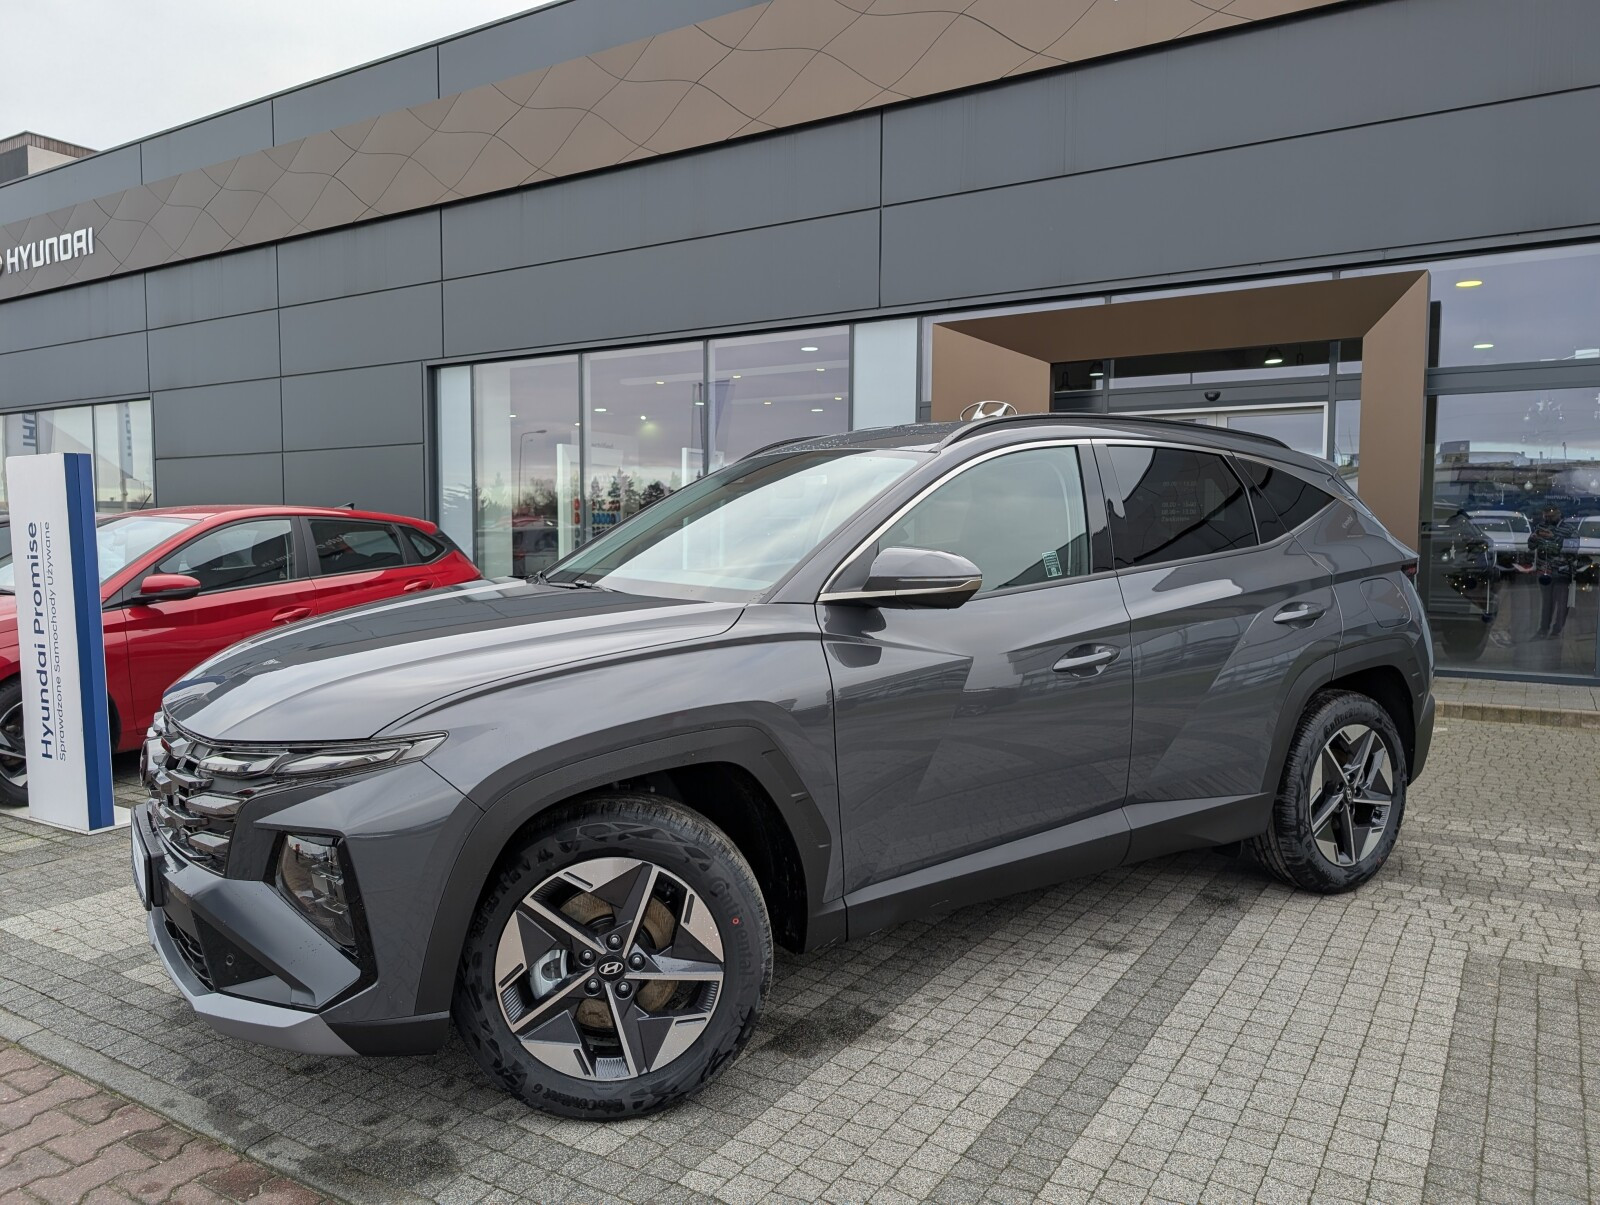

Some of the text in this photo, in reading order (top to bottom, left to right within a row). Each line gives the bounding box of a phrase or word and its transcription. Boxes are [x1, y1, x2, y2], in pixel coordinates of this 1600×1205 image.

[6, 226, 94, 274] HYUNDAI
[27, 522, 54, 760] Hyundai Promise
[48, 589, 62, 672] Samochody
[55, 676, 67, 762] Sprawdzone
[709, 877, 755, 976] Continental
